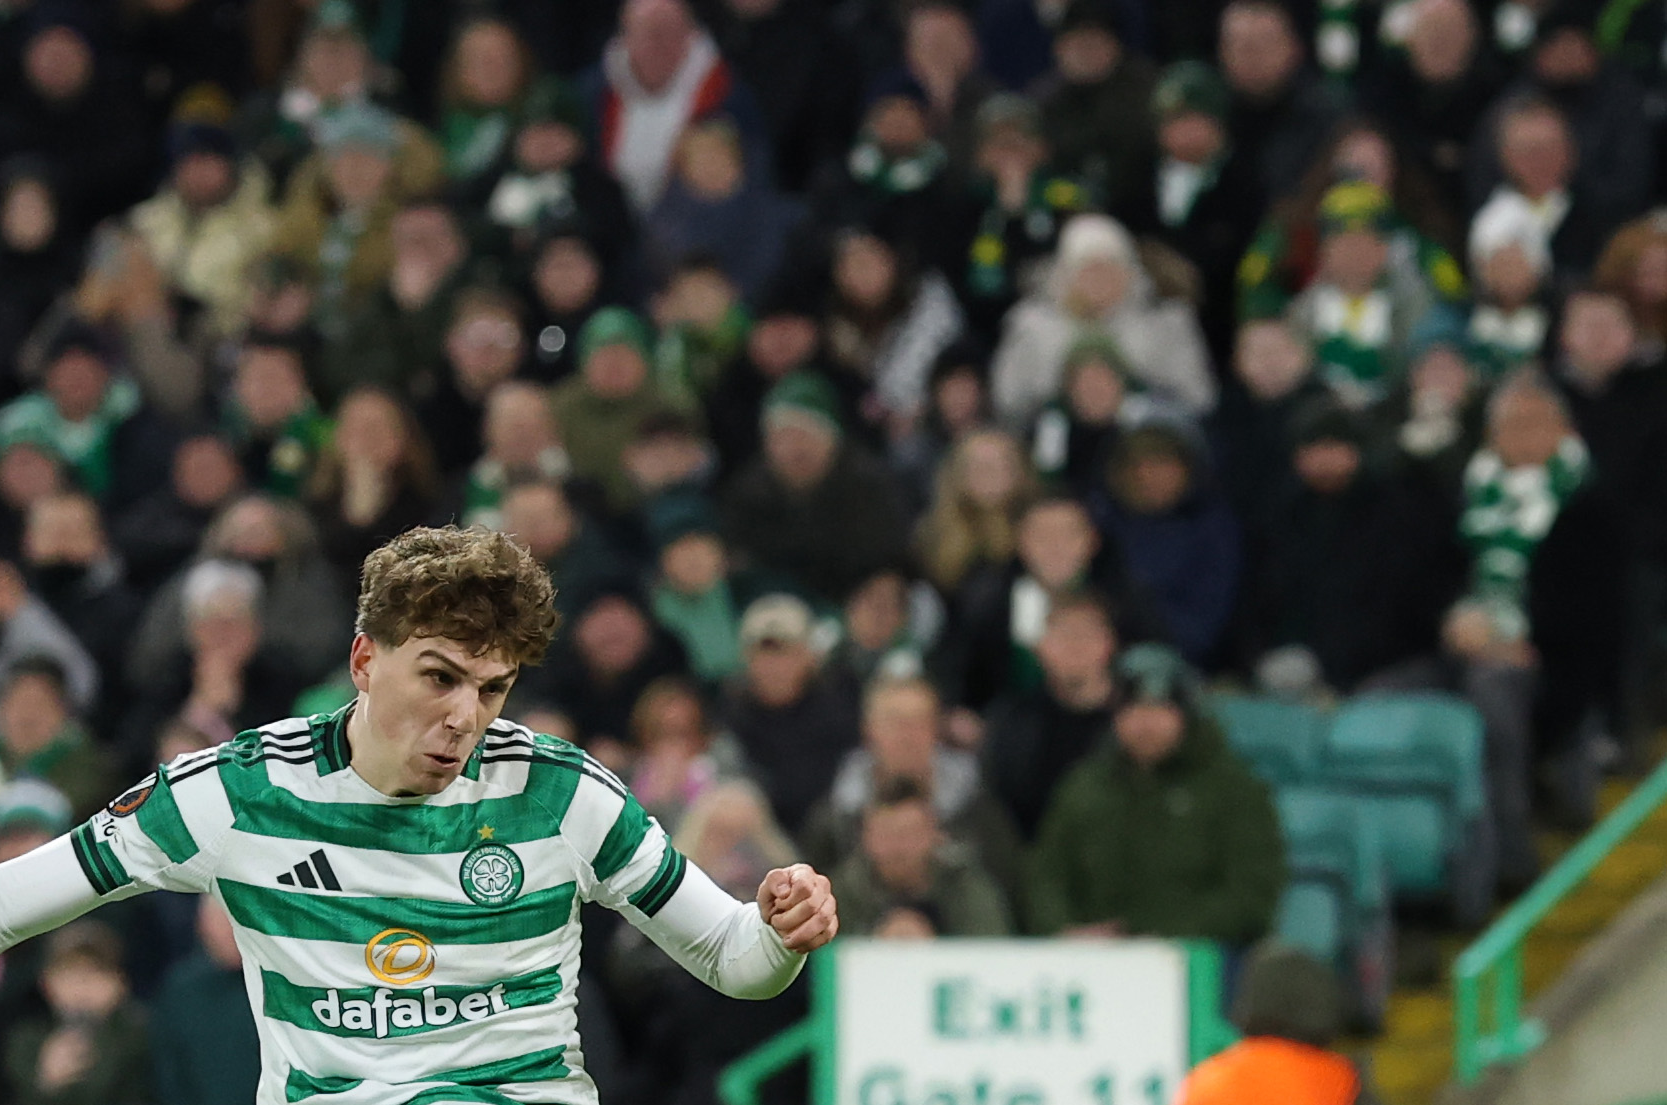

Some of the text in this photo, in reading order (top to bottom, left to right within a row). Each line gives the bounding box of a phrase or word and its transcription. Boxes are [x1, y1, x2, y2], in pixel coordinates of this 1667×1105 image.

[466, 851, 482, 868] CELTIC
[481, 847, 510, 859] FOOTBALL
[311, 982, 510, 1039] dafabet
[930, 974, 1087, 1042] Exit
